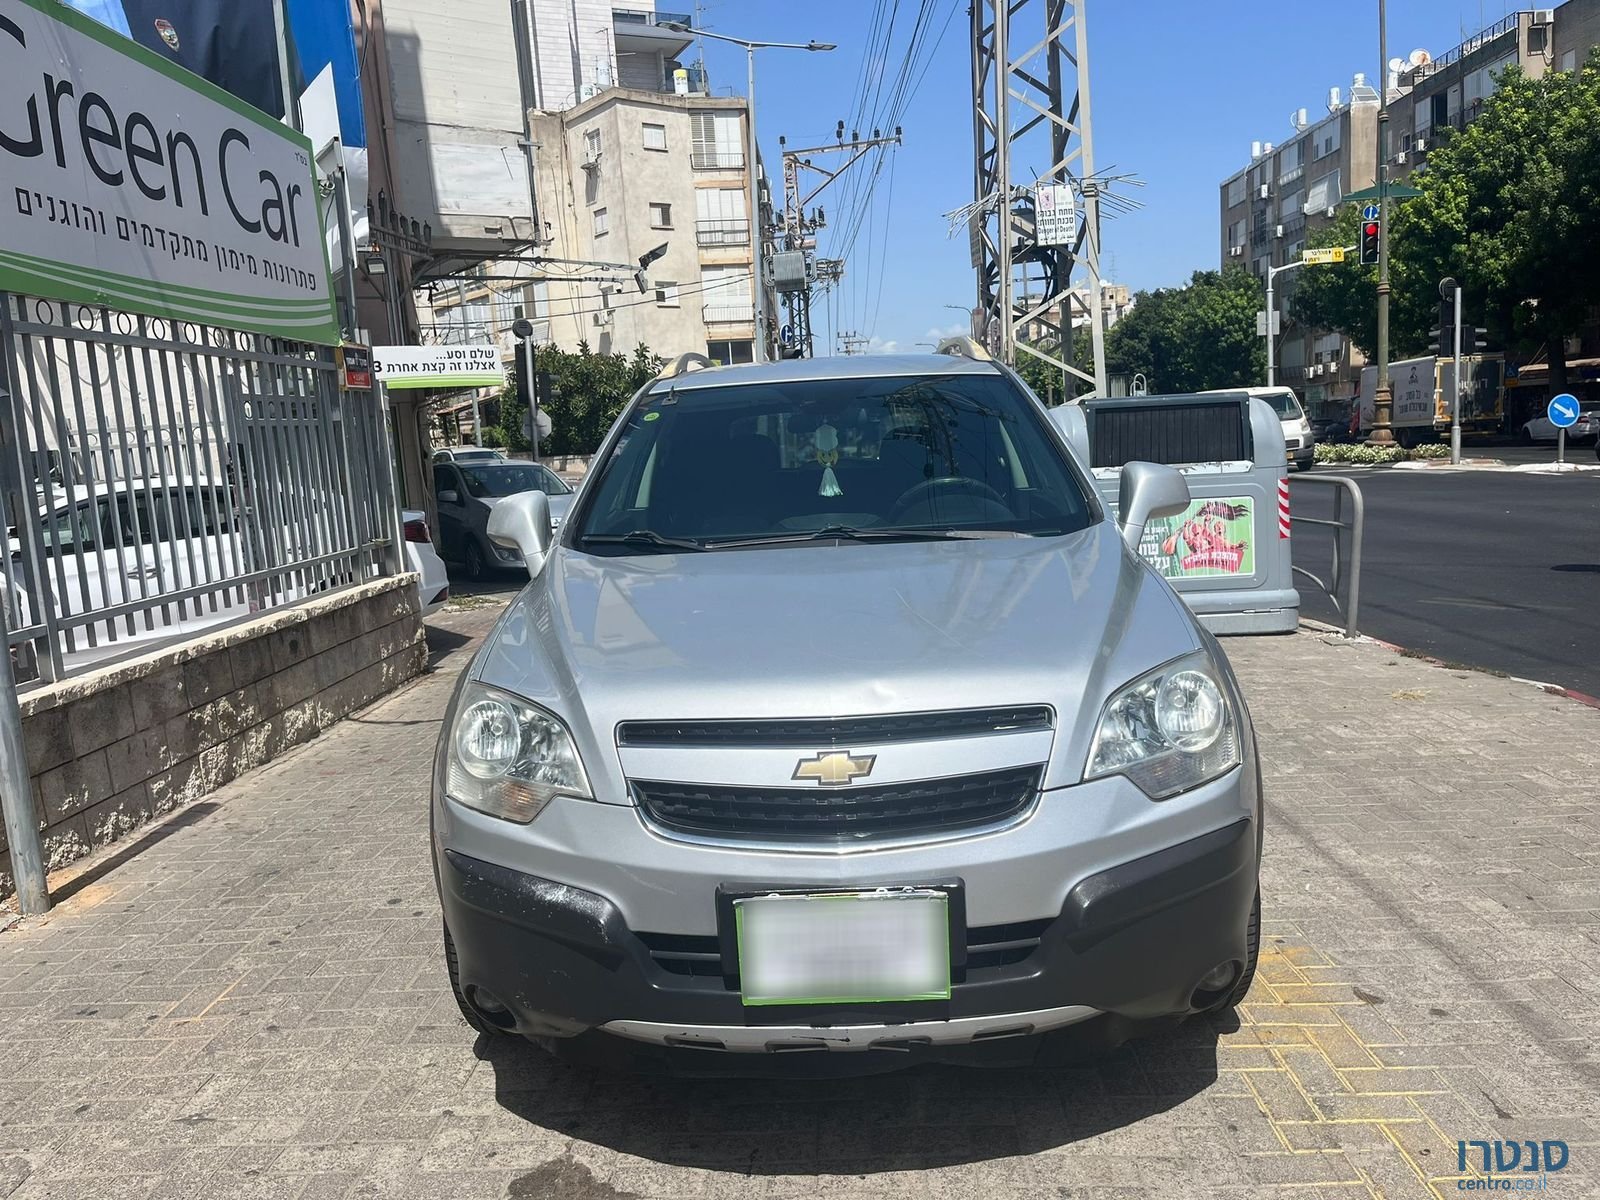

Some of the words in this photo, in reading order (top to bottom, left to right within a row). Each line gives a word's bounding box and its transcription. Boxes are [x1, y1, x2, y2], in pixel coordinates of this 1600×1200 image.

[219, 128, 302, 248] Car
[15, 186, 106, 235] והוגנים
[1058, 208, 1073, 216] מתח
[116, 215, 209, 262] מתקדמים
[214, 243, 258, 275] מימון
[262, 258, 317, 291] פתרונות
[435, 349, 466, 360] וסע...
[469, 348, 494, 359] שלם
[387, 362, 419, 373] אחרת
[422, 362, 446, 374] קצת
[450, 361, 462, 371] זה
[465, 359, 496, 371] אצלנו
